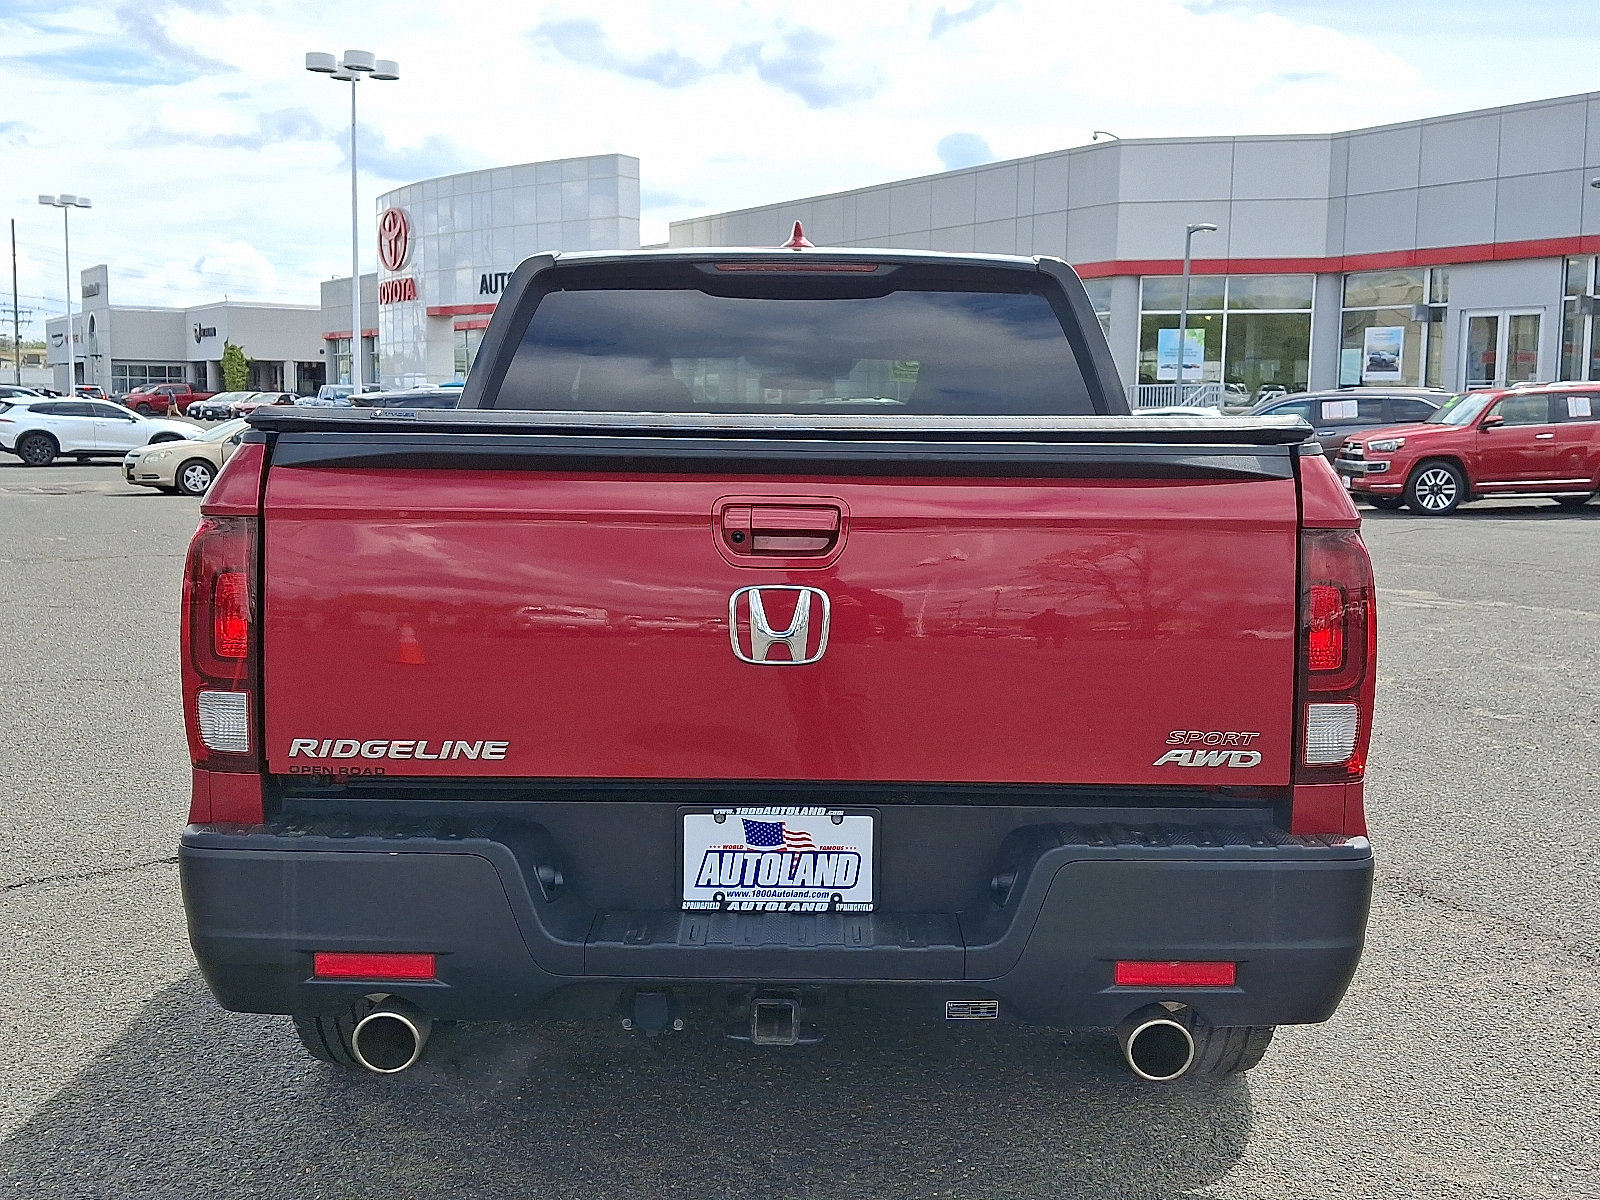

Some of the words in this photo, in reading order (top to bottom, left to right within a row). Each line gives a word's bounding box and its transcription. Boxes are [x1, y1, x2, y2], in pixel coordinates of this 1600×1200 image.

[1165, 730, 1261, 746] SPORT
[288, 738, 510, 760] RIDGELINE
[1152, 749, 1262, 768] AWD
[289, 766, 334, 774] OPEN
[339, 767, 386, 775] ROAD
[713, 806, 844, 816] www.1800AUTOLAND.com
[696, 851, 860, 888] AUTOLAND
[726, 889, 830, 899] www.1800Autoland.com
[682, 901, 721, 911] SPRINGFIELD
[727, 902, 829, 911] AUTOLAND
[835, 903, 874, 912] SPRINGFIELD
